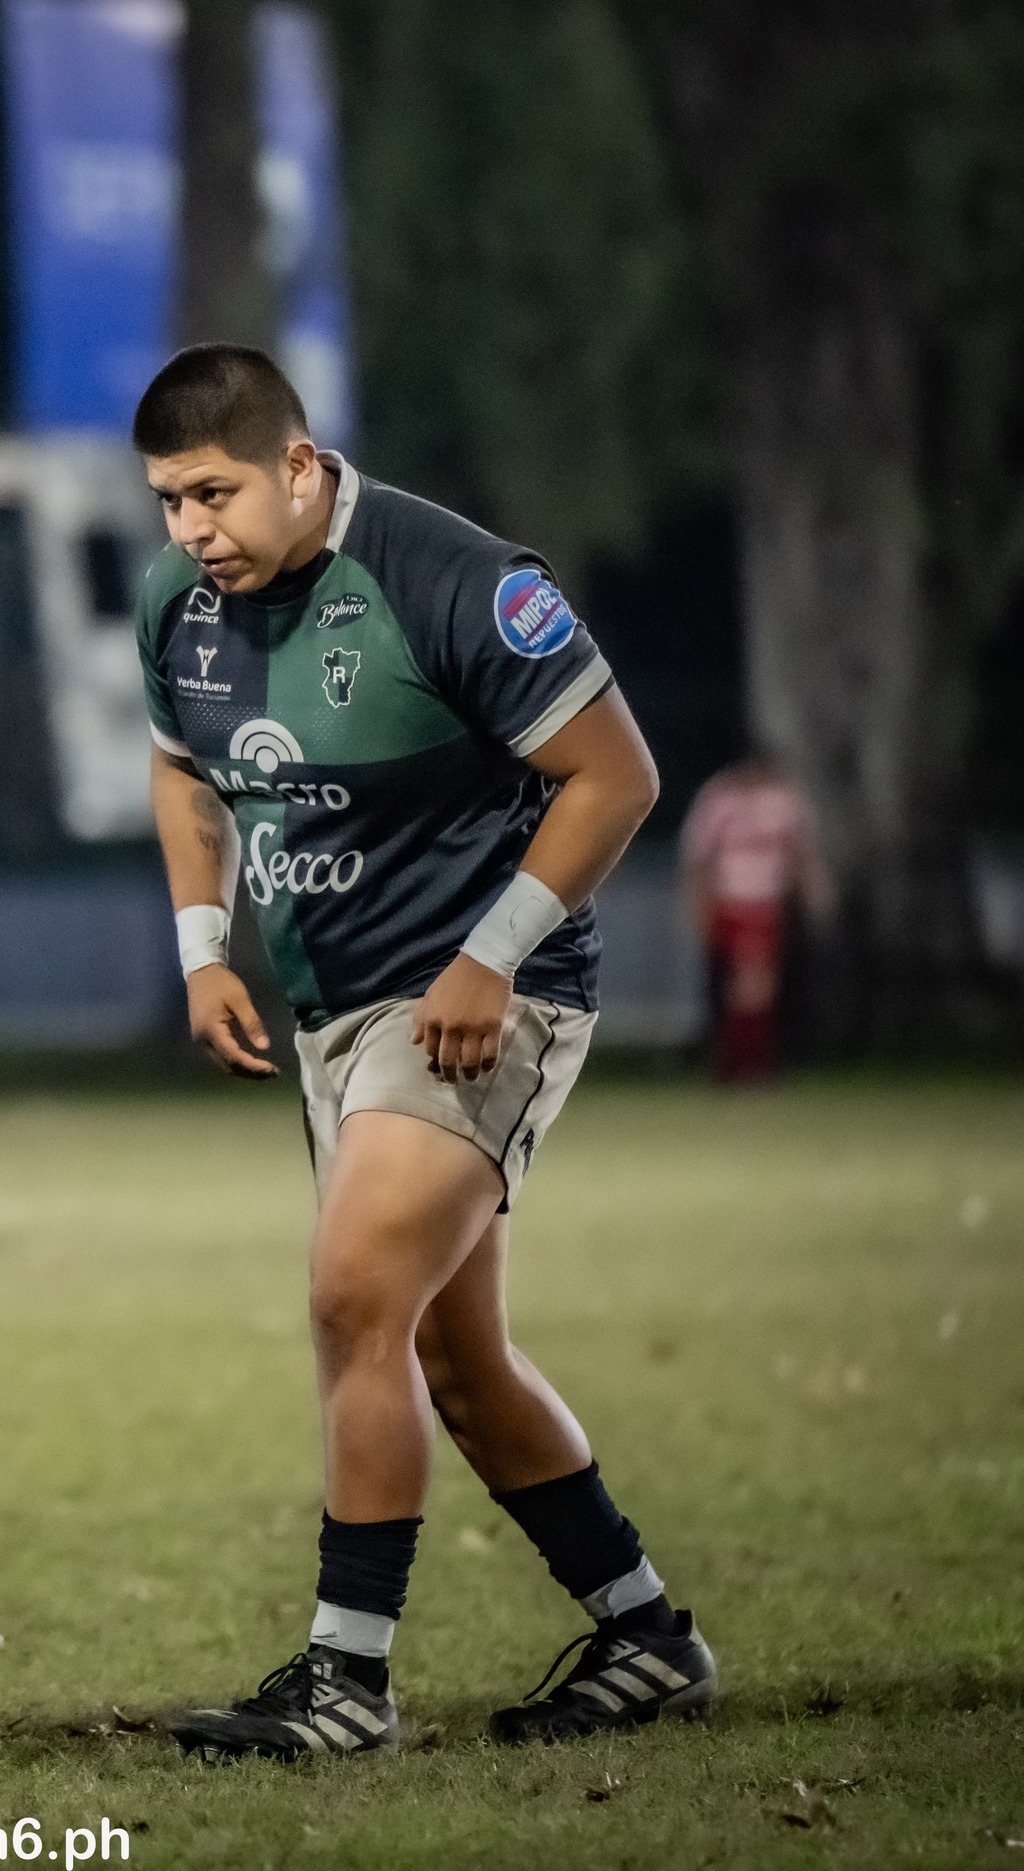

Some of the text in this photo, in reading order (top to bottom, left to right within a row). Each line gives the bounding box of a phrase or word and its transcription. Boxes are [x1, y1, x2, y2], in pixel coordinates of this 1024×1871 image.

[183, 611, 220, 624] quince
[316, 599, 368, 629] Balance
[332, 666, 346, 684] R
[177, 676, 232, 693] Yerba Buena
[245, 821, 364, 906] Secco
